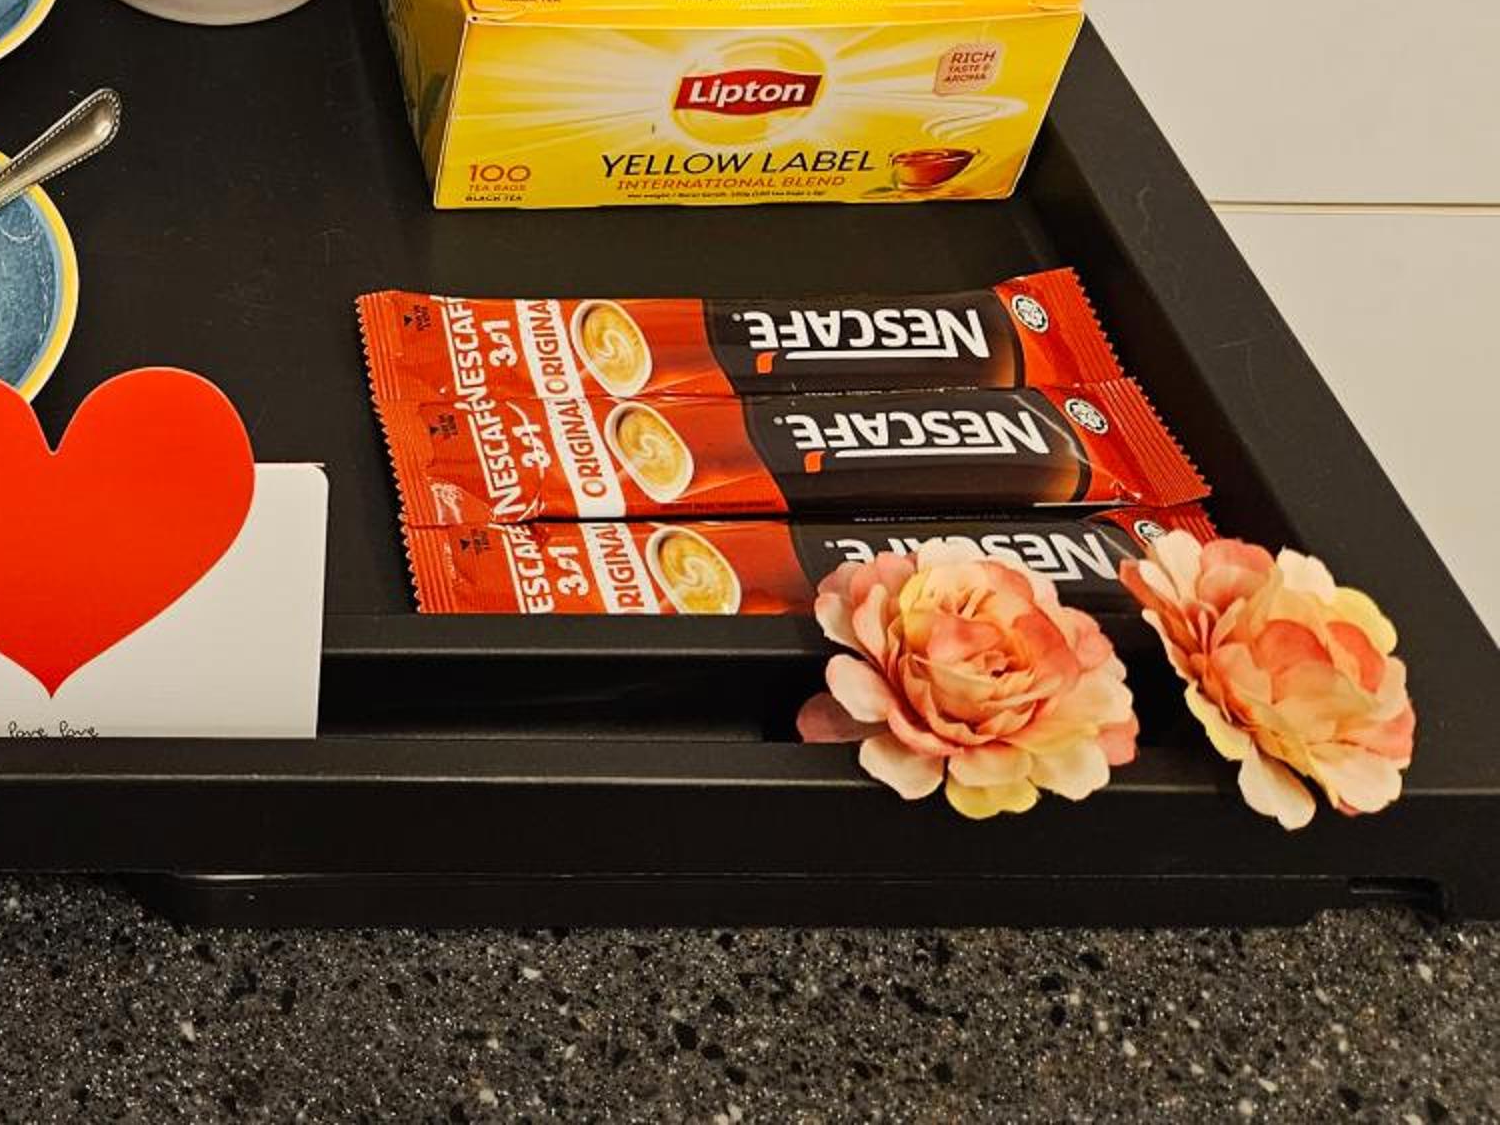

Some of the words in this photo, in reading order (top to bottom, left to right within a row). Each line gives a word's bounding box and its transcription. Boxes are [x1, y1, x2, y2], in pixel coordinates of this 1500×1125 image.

[950, 50, 997, 63] RICH
[688, 79, 806, 108] Lipton
[469, 164, 531, 182] 100
[601, 153, 754, 178] YELLOW
[760, 150, 876, 173] LABEL
[616, 177, 776, 190] INTERNATIONAL
[781, 176, 847, 188] BLEND
[430, 296, 489, 413] NESCAF
[528, 299, 569, 395] ORIGINA
[555, 399, 608, 499] ORIGINAL
[593, 523, 646, 609] RIGINAL
